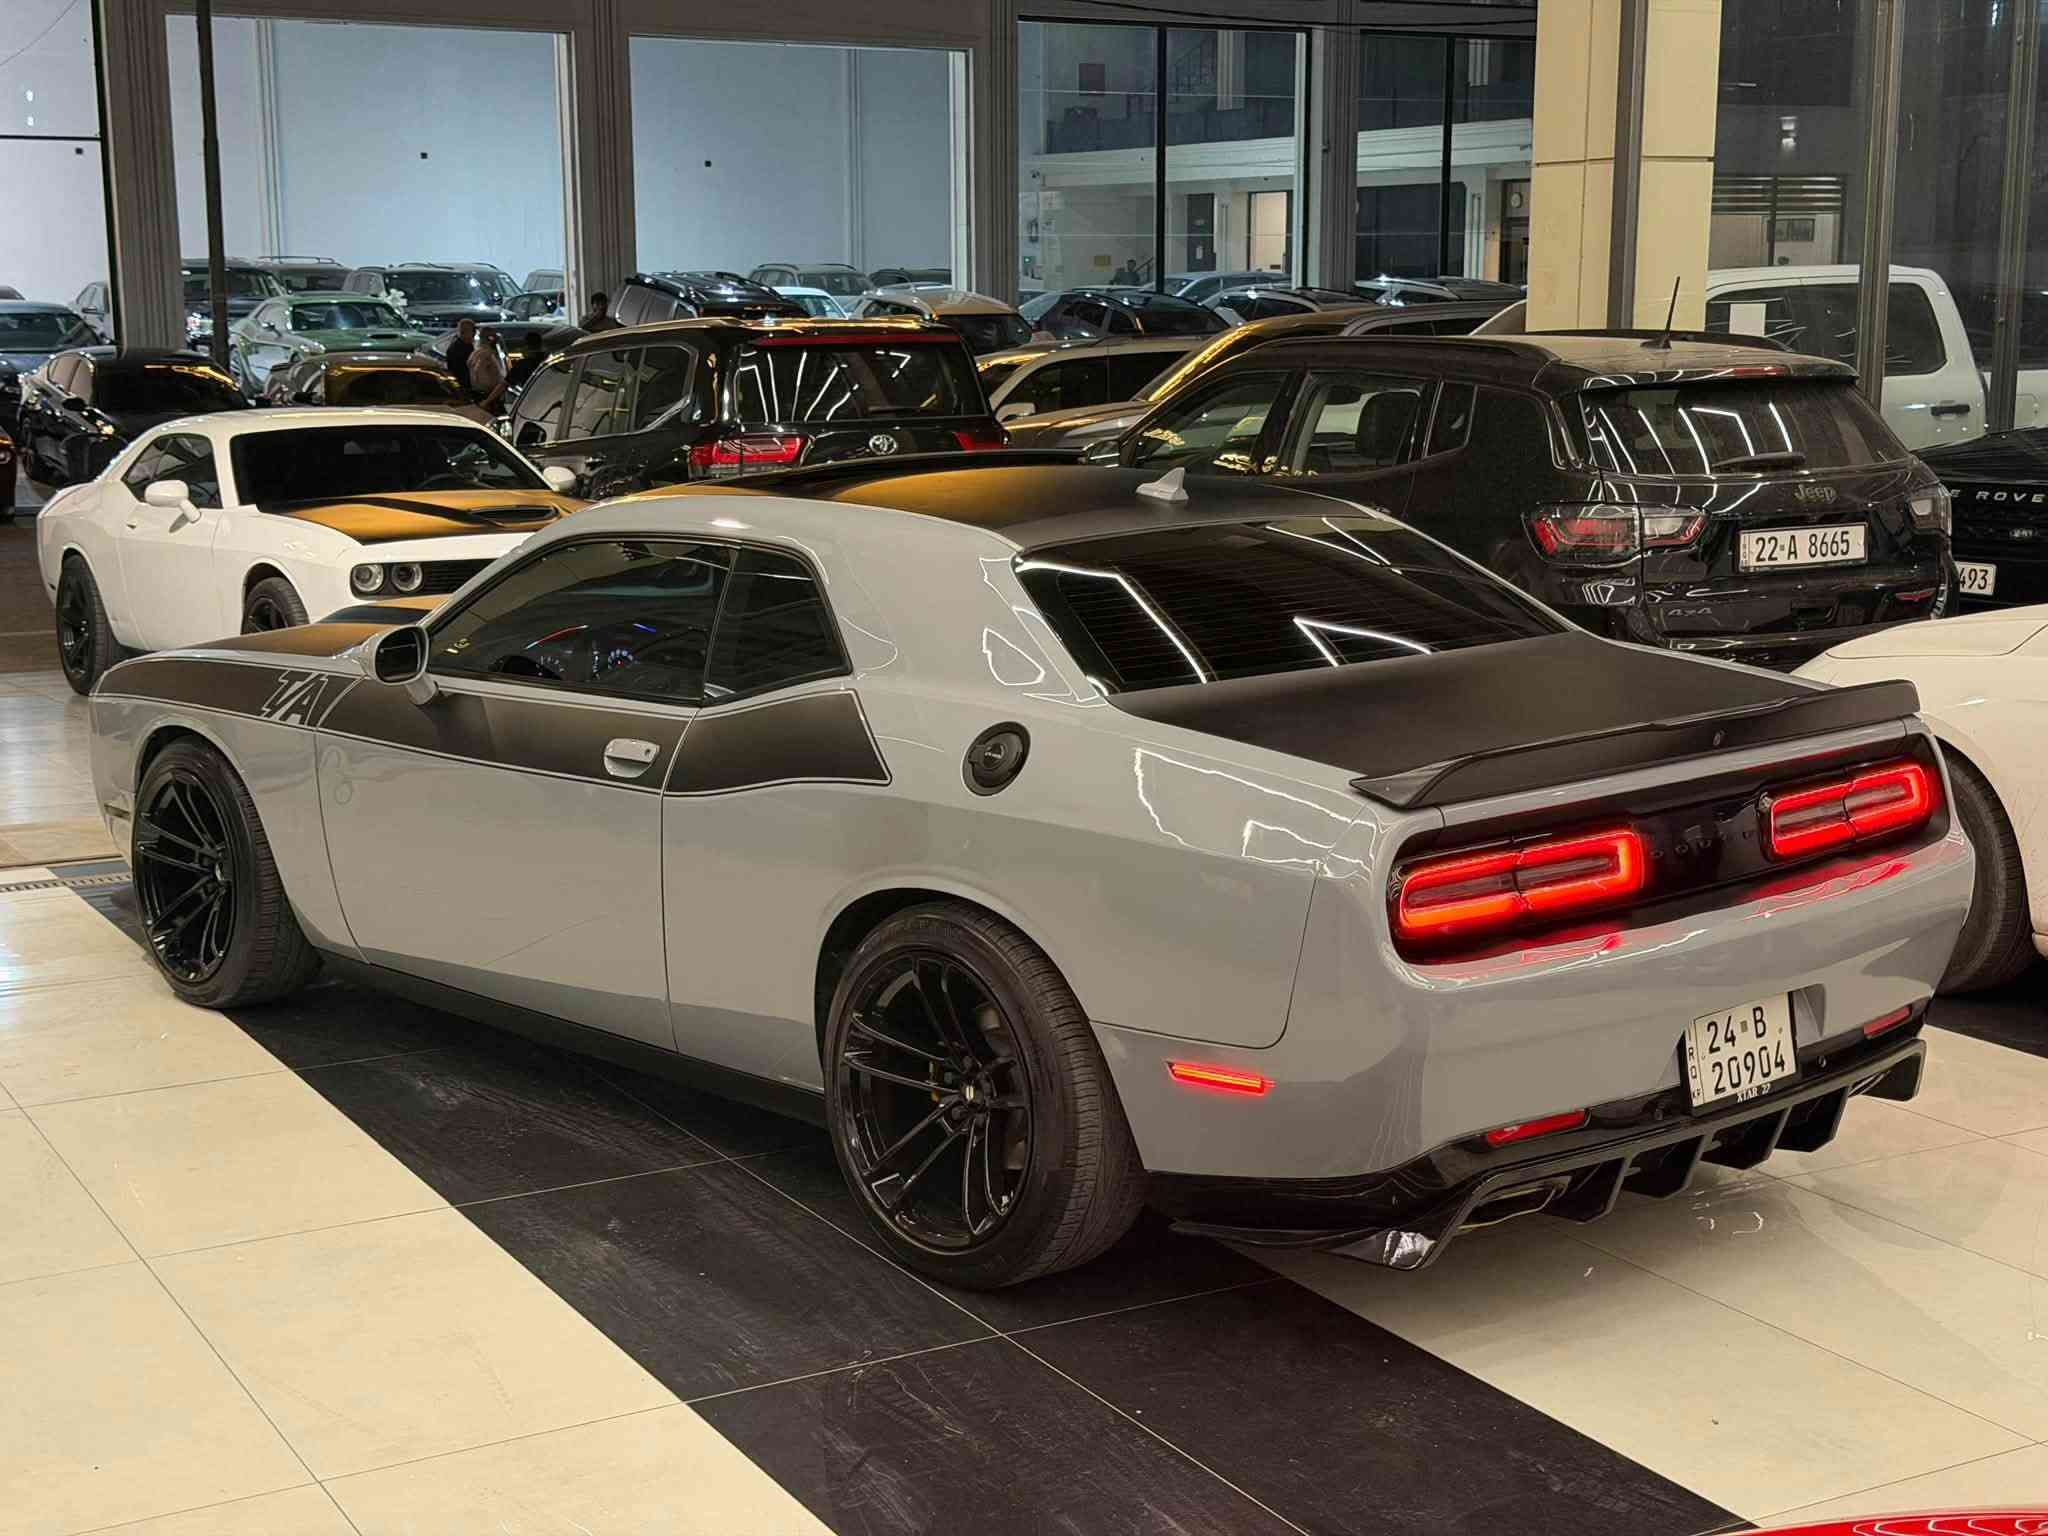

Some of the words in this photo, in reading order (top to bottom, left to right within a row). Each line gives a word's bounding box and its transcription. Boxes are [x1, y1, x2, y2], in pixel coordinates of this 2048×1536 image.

[1794, 484, 1838, 504] Jeep
[1808, 530, 1850, 559] 8665
[1711, 1039, 1786, 1095] 20904
